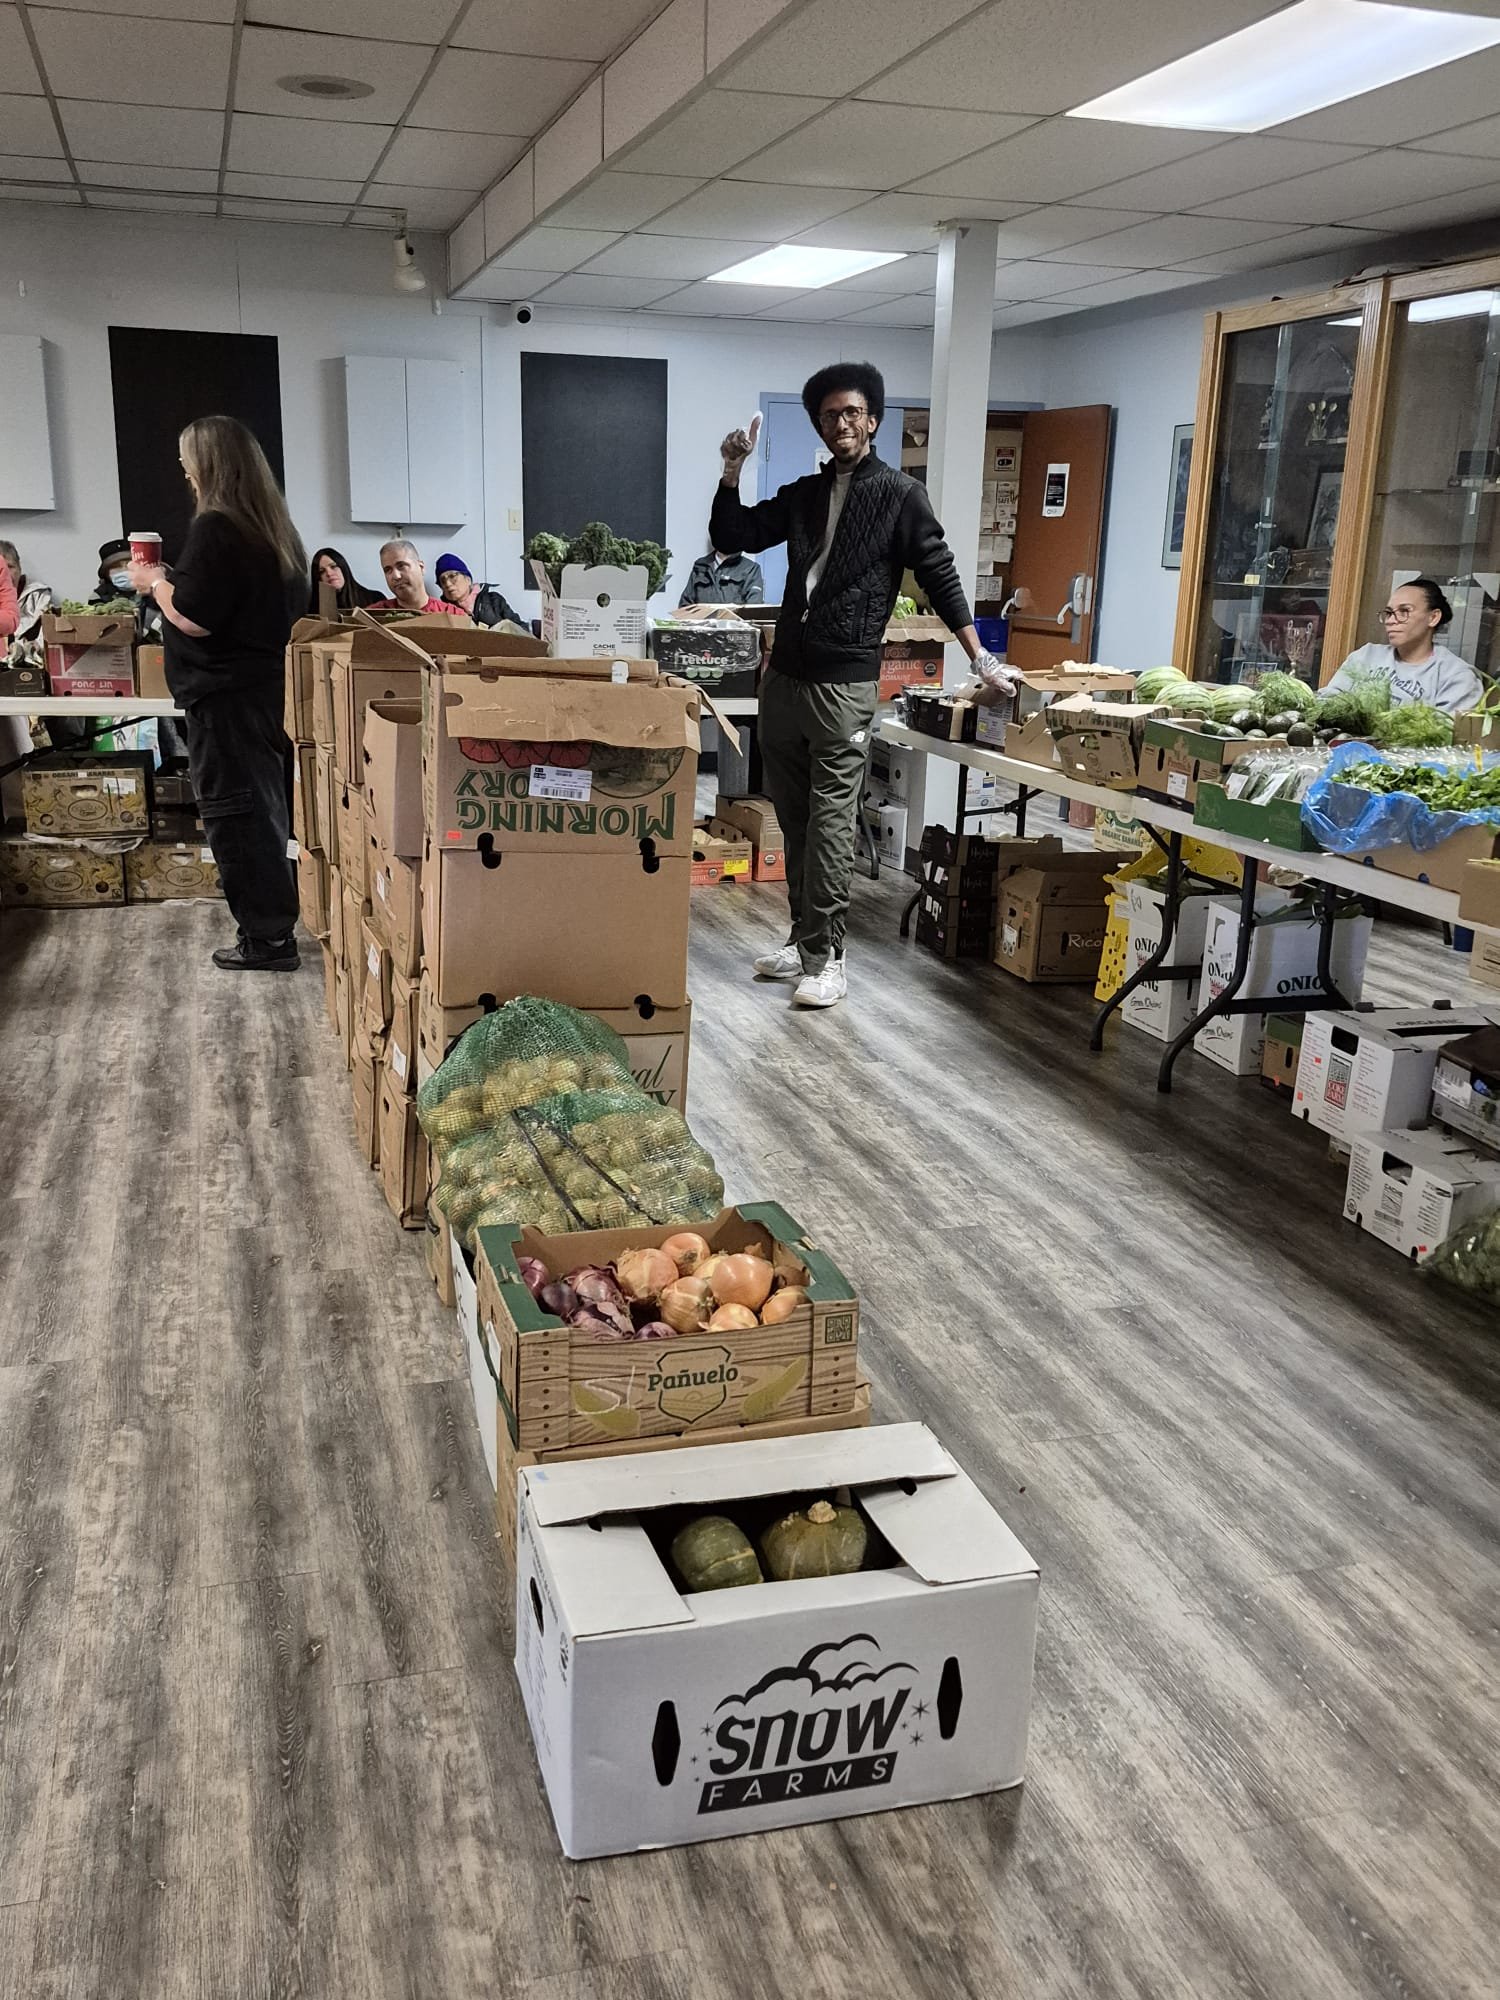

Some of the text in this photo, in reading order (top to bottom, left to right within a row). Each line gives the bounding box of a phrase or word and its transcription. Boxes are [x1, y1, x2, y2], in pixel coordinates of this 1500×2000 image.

[881, 660, 921, 673] rganic
[1389, 670, 1425, 699] ANGELES
[456, 791, 677, 840] MORNING
[1134, 937, 1159, 955] ONIO
[1277, 975, 1336, 994] ONIO
[648, 1364, 738, 1391] Pañuelo
[708, 1757, 889, 1807] FARMS
